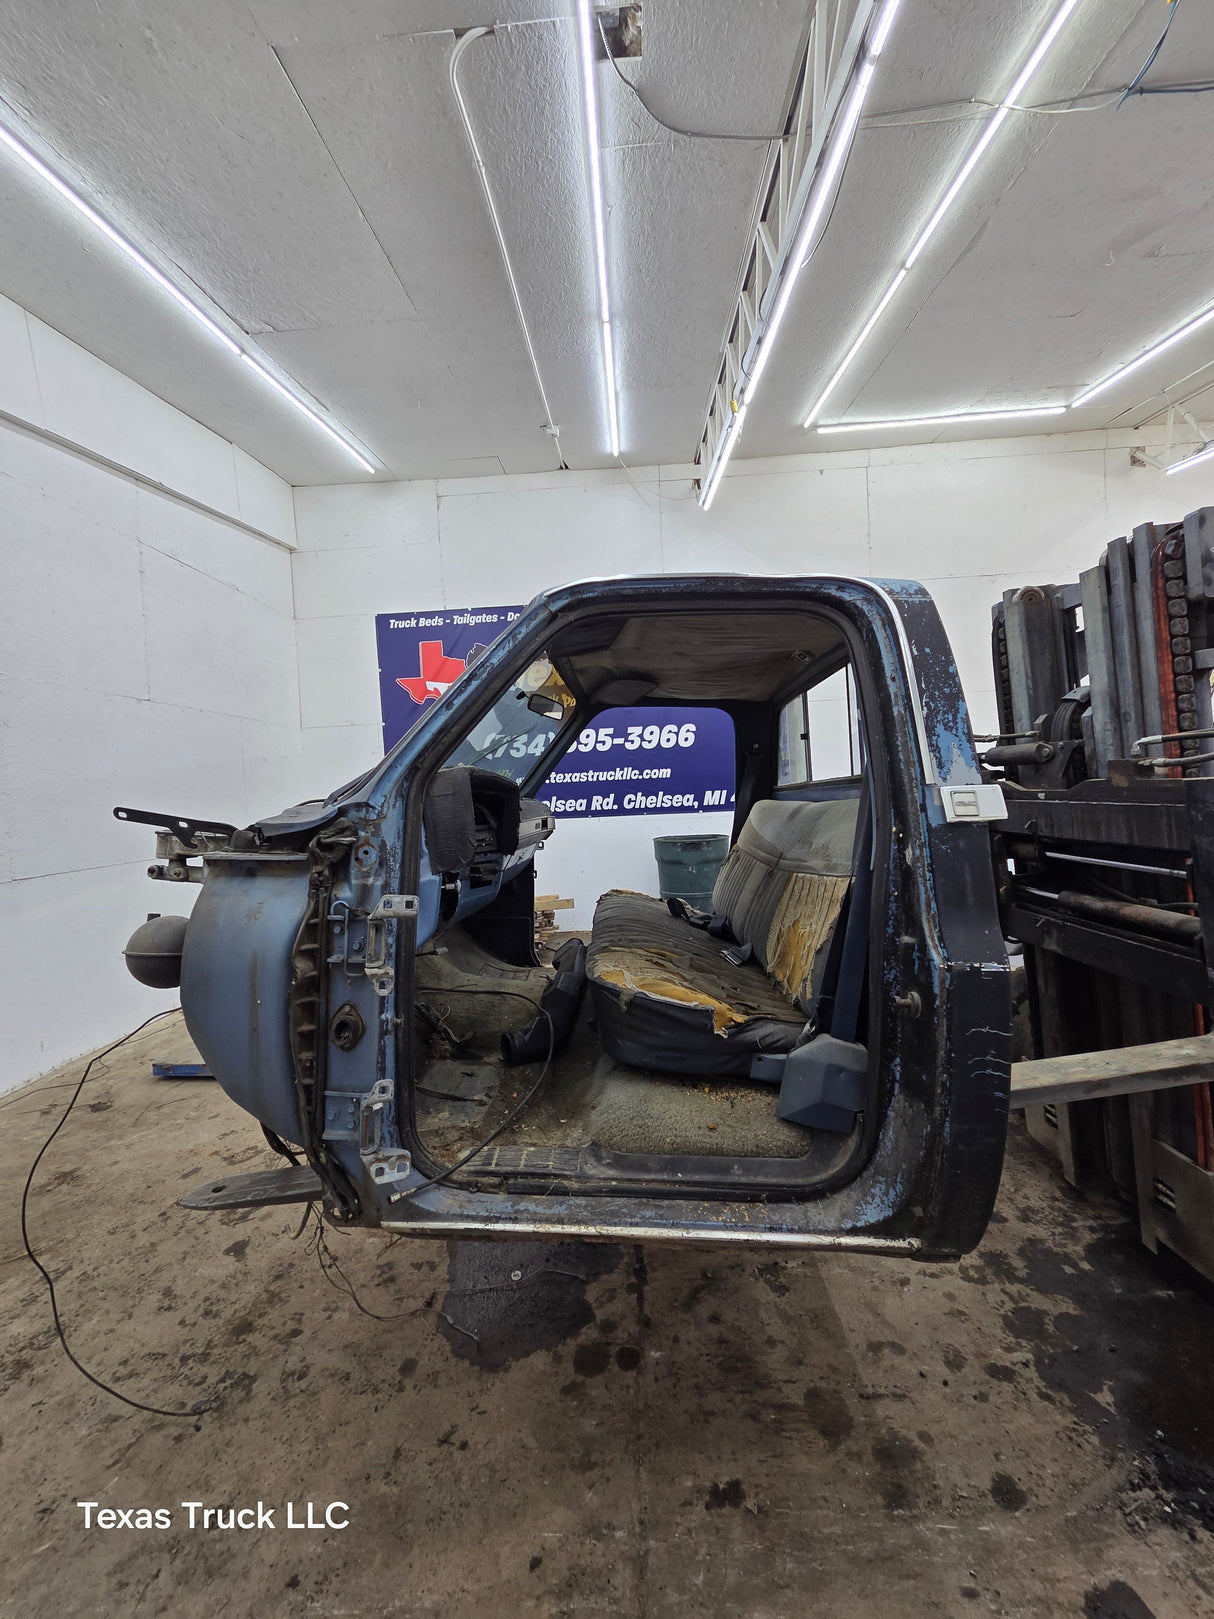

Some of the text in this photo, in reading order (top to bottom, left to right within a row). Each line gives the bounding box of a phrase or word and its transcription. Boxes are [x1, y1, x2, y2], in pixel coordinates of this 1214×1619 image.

[389, 617, 417, 629] Truck
[419, 615, 444, 627] Beds
[453, 613, 498, 626] Tailgates
[591, 793, 618, 811] Rd.
[623, 791, 699, 810] Chelsea,
[703, 789, 728, 806] MI
